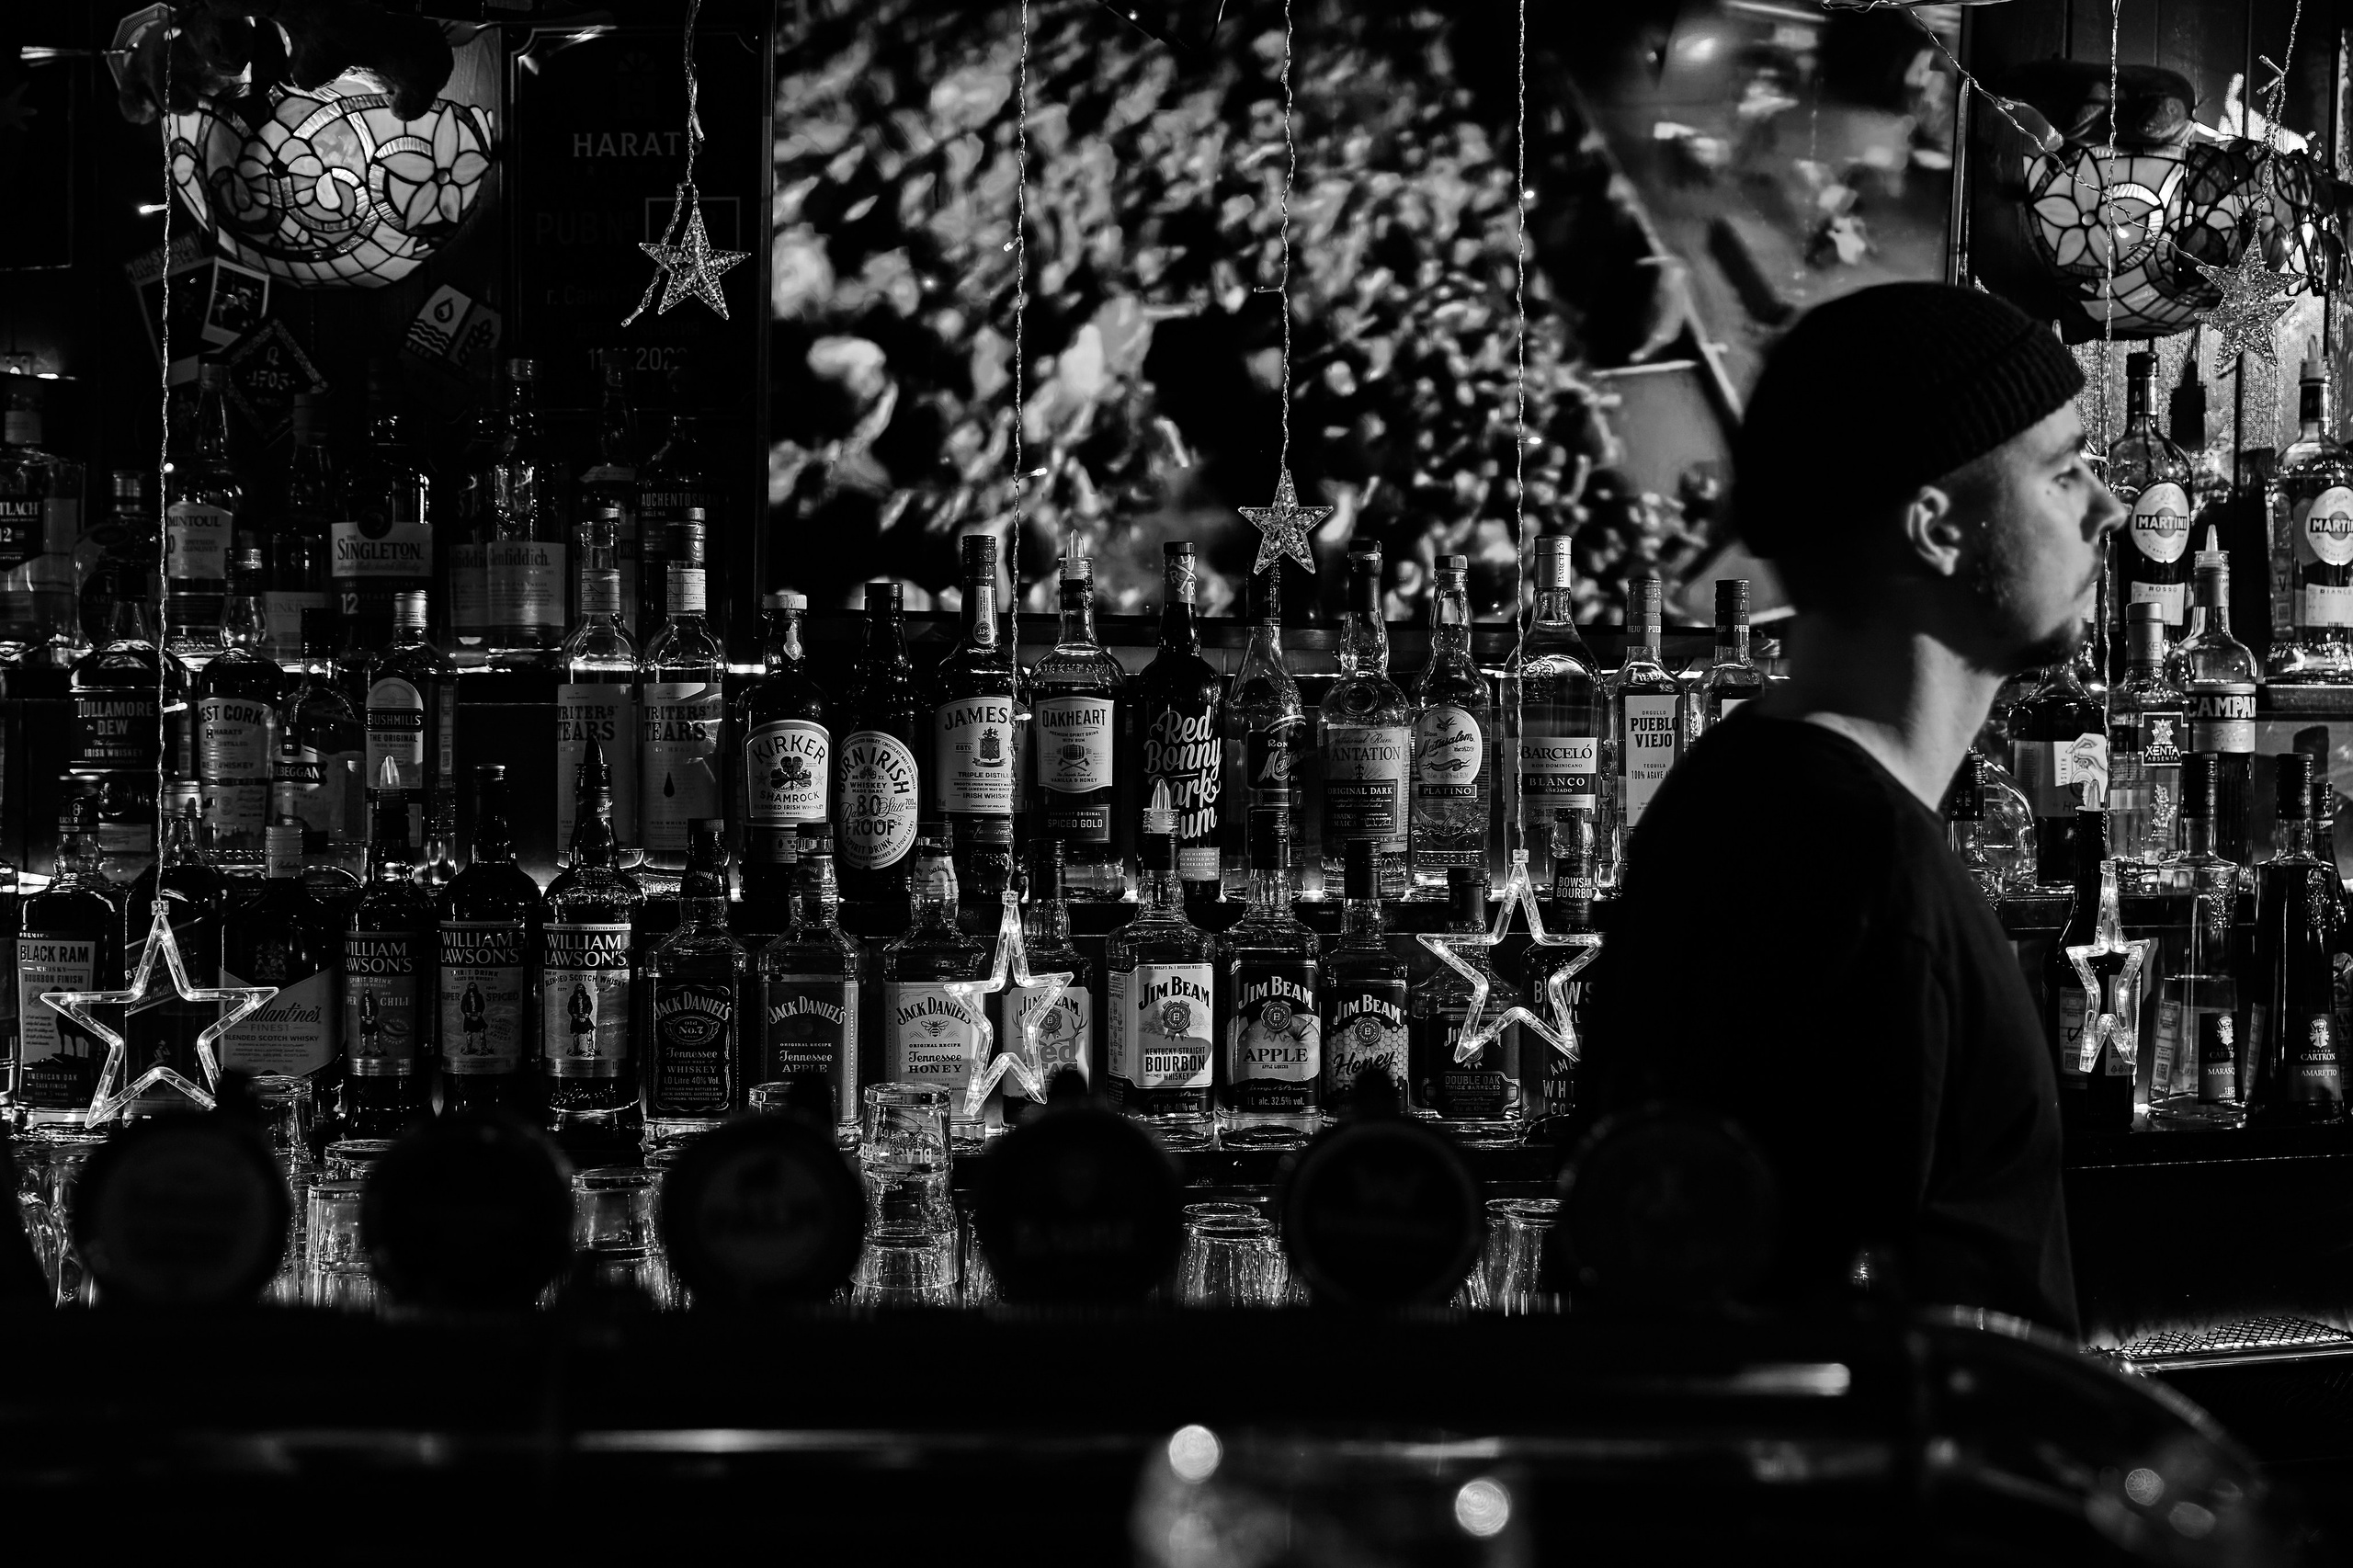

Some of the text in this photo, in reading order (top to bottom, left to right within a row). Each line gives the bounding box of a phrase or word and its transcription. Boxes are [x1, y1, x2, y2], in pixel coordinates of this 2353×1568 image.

[2138, 516, 2187, 530] MARTINI
[2312, 518, 2353, 533] MARTI
[336, 537, 423, 561] SINGLETON
[340, 592, 360, 615] 12
[74, 698, 155, 719] TULLAMORE
[199, 703, 265, 726] EST CORK
[367, 712, 422, 727] BUSHMILLS
[1042, 708, 1107, 728] OAKHEART
[1149, 704, 1213, 745] Red
[1630, 717, 1680, 732] PUEBLO
[369, 733, 418, 743] THE ORIGINAL
[1634, 733, 1673, 748] VIEJO
[84, 748, 143, 758] IRISH WHISKEY
[752, 734, 826, 765] KIRKER
[1322, 745, 1401, 762] LANTATION
[1520, 744, 1593, 762] BARCELÓ
[2144, 744, 2181, 757] XENTA
[1142, 736, 1222, 783] Bonny
[837, 745, 910, 795] BORN IRISH
[1631, 770, 1664, 779] 100% AGAVE
[1148, 767, 1222, 809] ark
[1529, 777, 1586, 787] BLANCO
[759, 790, 820, 803] SHAMROCK
[1327, 786, 1393, 796] ORIGINAL DARK
[1423, 787, 1472, 796] PLATINO
[857, 794, 881, 817] 80
[1047, 818, 1103, 828] SPICED GOLD
[1179, 805, 1219, 840] um
[845, 836, 893, 855] SPIRIT DRINK
[441, 931, 514, 949] WILLIAM
[546, 933, 622, 950] WILLIAM
[19, 945, 89, 963] BLACK RAM
[440, 947, 519, 964] LAWSON'S
[544, 949, 628, 967] LAWSON'S
[24, 973, 84, 983] BOURBON FINISH
[348, 976, 392, 985] SPIRIT DRINK
[450, 969, 500, 978] SPIRIT DRINK
[544, 973, 627, 989] BLENDED SCOTCH WHISKY
[485, 992, 519, 1002] SPICED
[1138, 975, 1211, 1011] JIM BEAM
[1237, 975, 1314, 1012] JIM BEAM
[380, 996, 410, 1007] CHILI
[654, 991, 733, 1021] JACK DANIEL'S
[229, 998, 322, 1024] allantine's
[767, 995, 847, 1026] JACK DANIEL'S
[895, 1001, 927, 1026] JACK
[1333, 994, 1403, 1028] JIM BEAM
[250, 1024, 290, 1032] FINEST
[678, 1026, 704, 1035] No.7
[665, 1046, 718, 1059] Tennessee
[779, 1050, 833, 1062] Tennessee
[908, 1051, 962, 1062] Tennessee
[1040, 1038, 1078, 1064] ed
[1145, 1046, 1206, 1056] KENTUCKY STRAIGHT
[1243, 1048, 1309, 1062] APPLE
[2300, 1052, 2336, 1062] CARTRON
[666, 1065, 717, 1074] WHISKEY
[781, 1063, 828, 1074] APPLE
[908, 1064, 962, 1074] HONEY
[1145, 1054, 1206, 1073] BOURBON
[1333, 1051, 1397, 1077] Honey
[27, 1073, 78, 1082] AMERICAN OAK
[664, 1075, 721, 1085] 1.0 Litre 40% Vol.
[1163, 1073, 1190, 1081] WHISKEY
[1444, 1075, 1501, 1085] DOUBLE OAK
[2301, 1069, 2337, 1077] AMARETTO
[1153, 1103, 1199, 1112] 1L alc. 40% vol.
[1258, 1096, 1305, 1106] alc. 32.5% vol.
